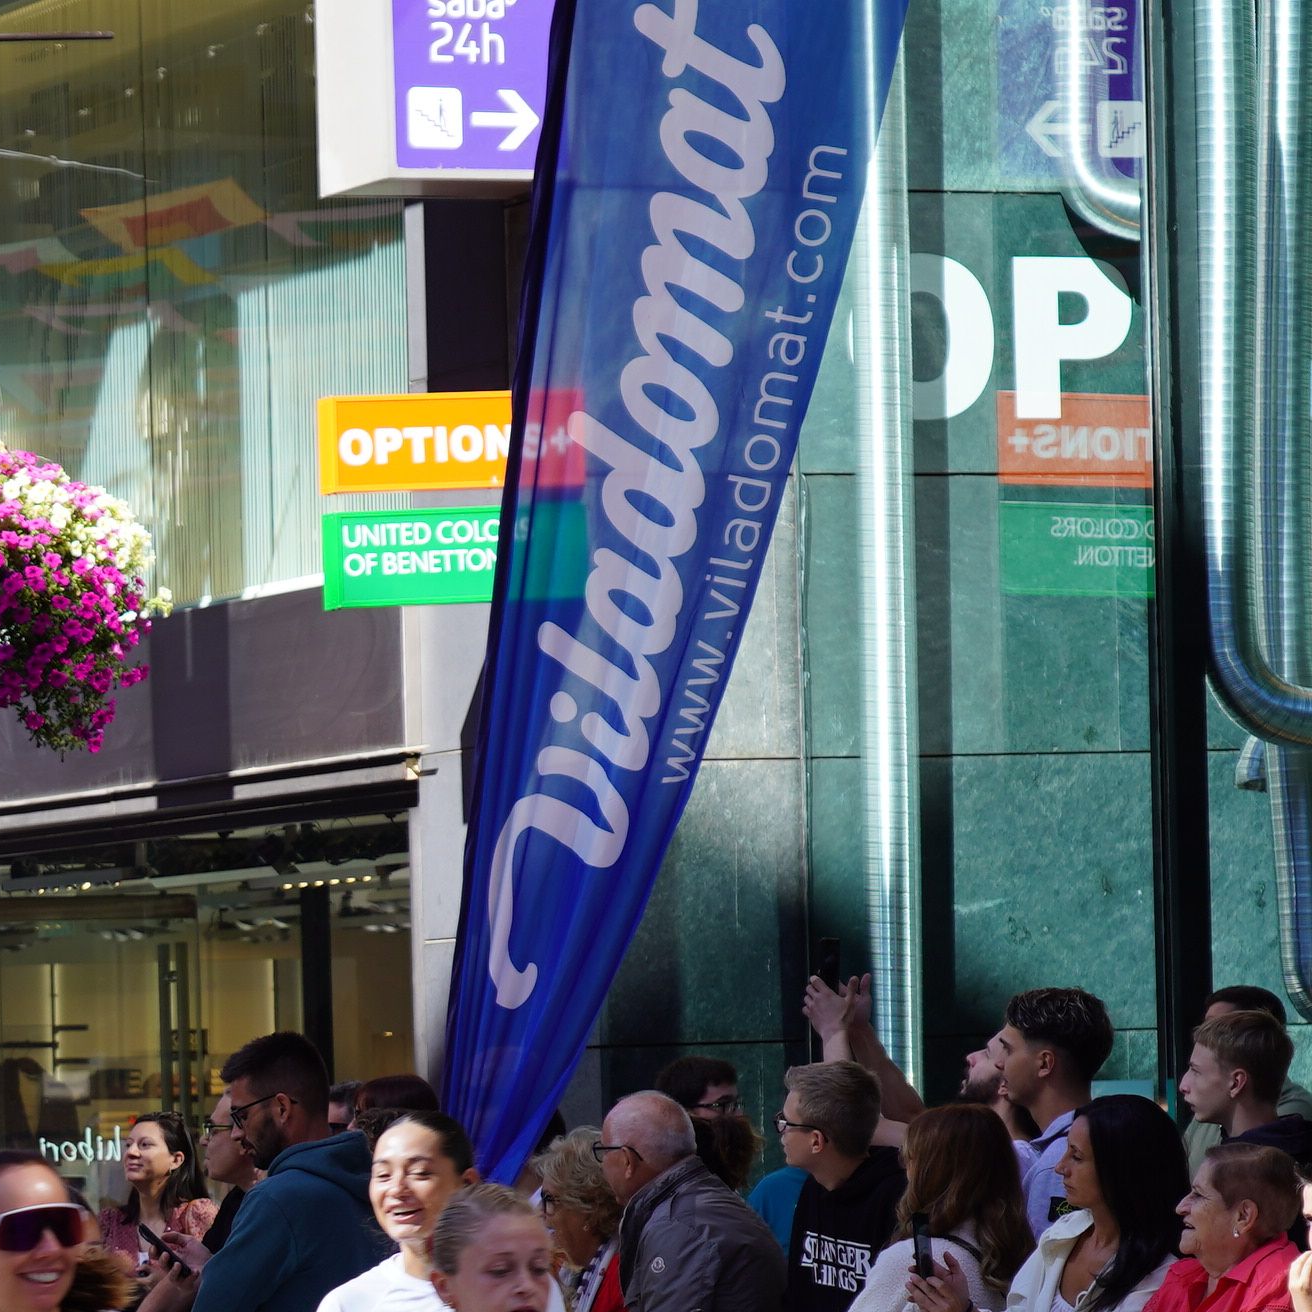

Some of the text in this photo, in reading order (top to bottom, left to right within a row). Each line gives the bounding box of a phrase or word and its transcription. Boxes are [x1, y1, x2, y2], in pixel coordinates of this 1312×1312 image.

[428, 21, 506, 65] 24h
[661, 143, 848, 785] www.viladomat.com
[487, 0, 787, 1010] Viladomat
[341, 520, 432, 549] UNITED
[342, 552, 378, 577] OF
